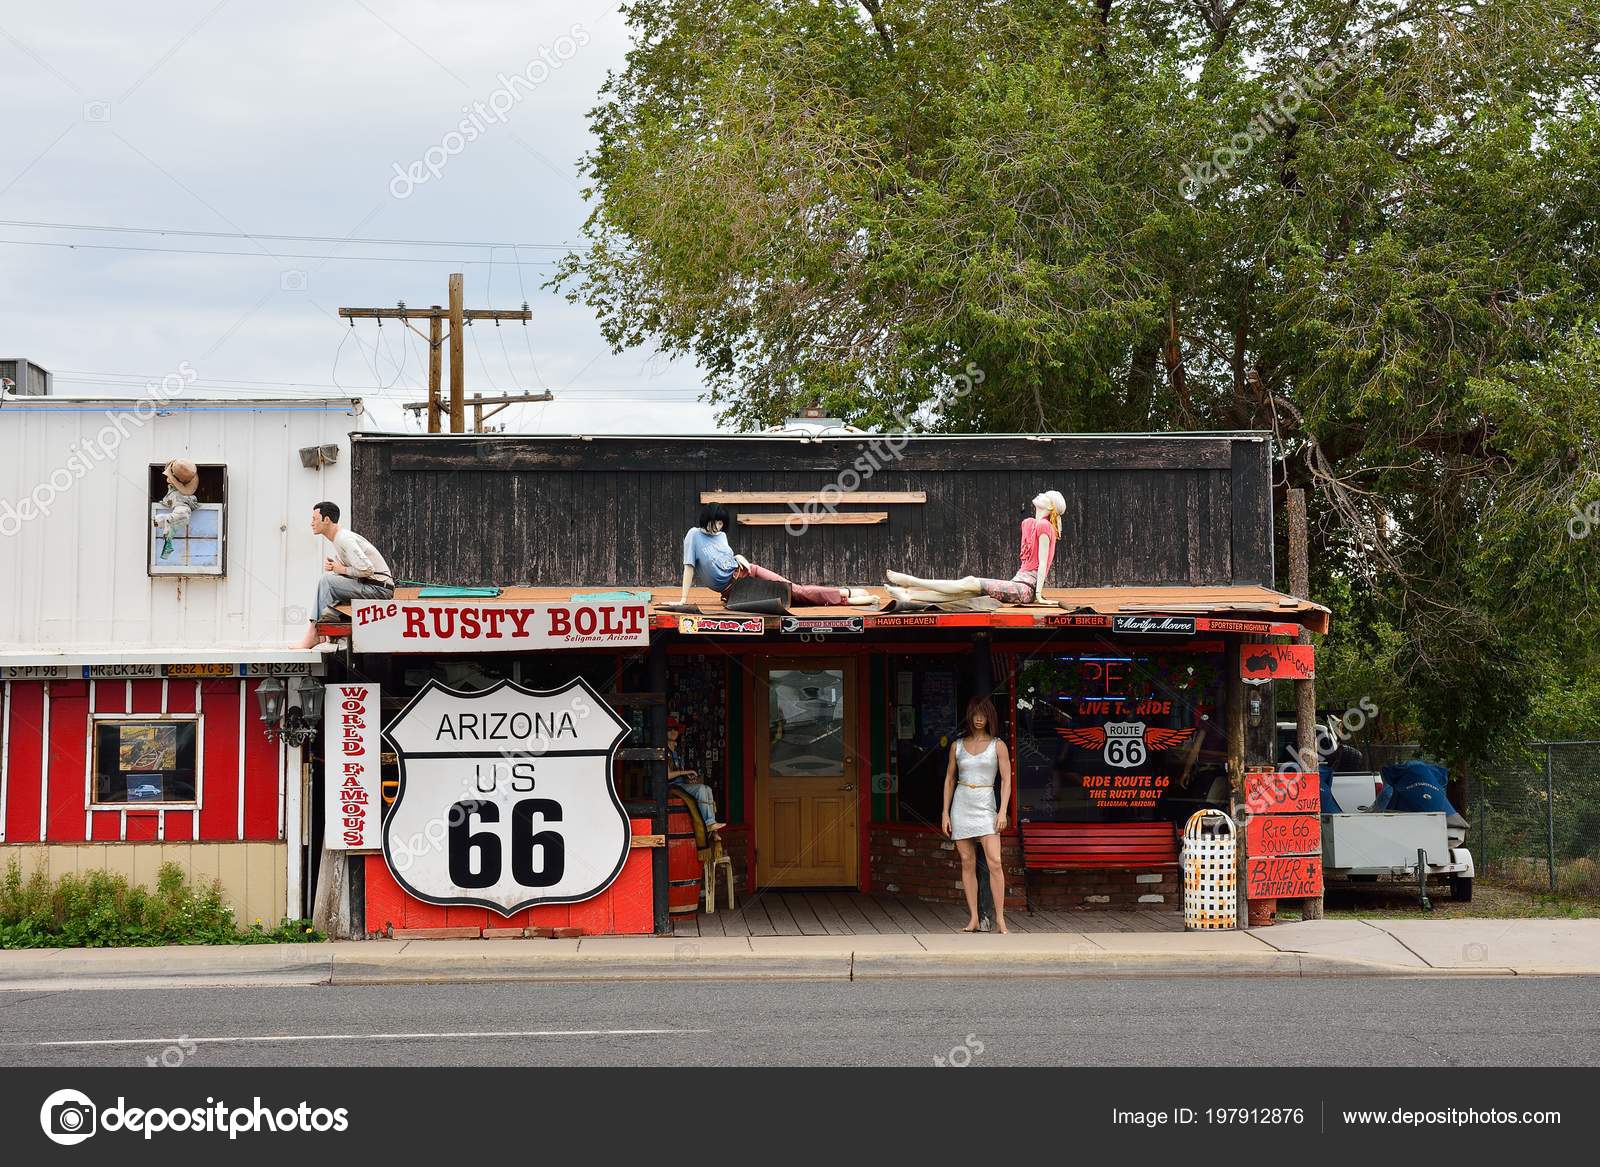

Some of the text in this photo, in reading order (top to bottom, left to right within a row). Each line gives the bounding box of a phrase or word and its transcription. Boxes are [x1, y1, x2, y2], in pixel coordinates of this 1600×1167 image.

[357, 603, 645, 639] The RUSTY BOLT
[877, 617, 935, 626] HAWG HEAVEN
[1048, 616, 1104, 625] LADY BIKER
[1120, 617, 1192, 632] Marilyn Monroe
[1211, 621, 1269, 632] SPORTSTER HIGHWAY
[564, 634, 604, 643] Seligman,
[43, 665, 58, 676] 98
[168, 663, 196, 674] 2852
[218, 663, 233, 674] 35
[1079, 701, 1110, 715] LIVE
[1136, 700, 1173, 715] RIDE
[436, 712, 578, 741] ARIZONA
[1110, 726, 1140, 735] ROUTE
[1107, 739, 1142, 764] 66
[339, 687, 369, 847] WORLD FAMOUS
[1082, 776, 1170, 787] RIDE ROUTE 66
[1089, 789, 1162, 799] THE RUSTY BOLT
[1296, 798, 1319, 811] STUFF
[1292, 819, 1310, 838] 66
[448, 797, 565, 889] 66
[1251, 859, 1302, 883] BIKER
